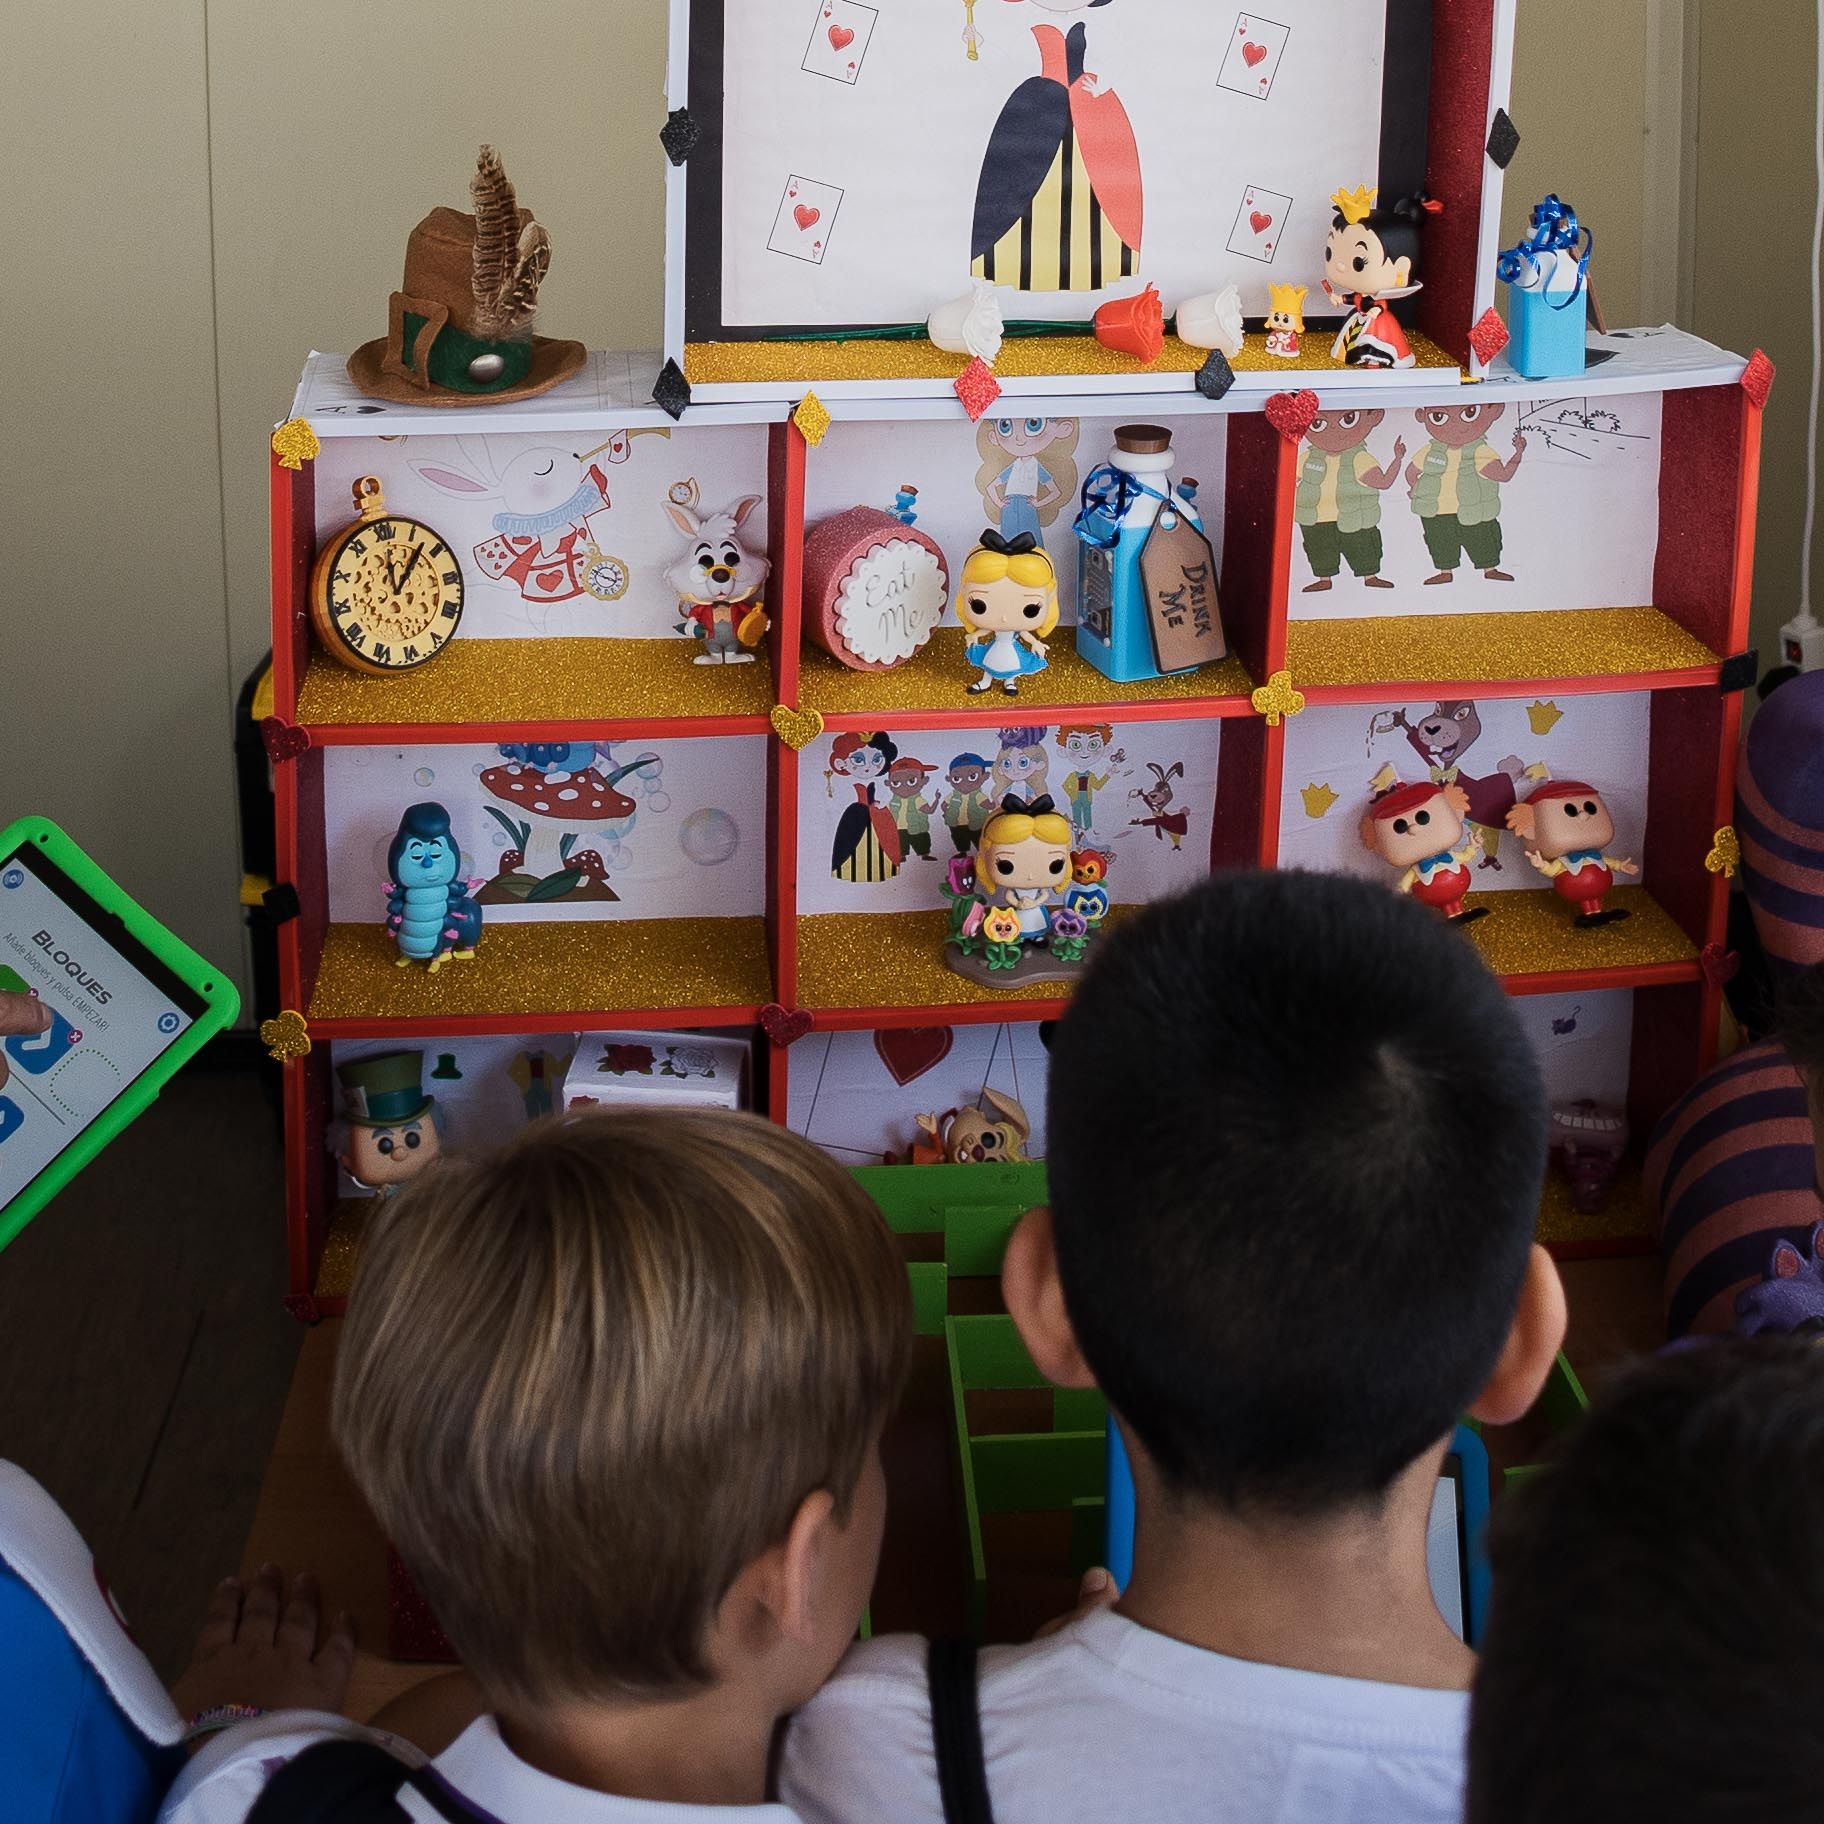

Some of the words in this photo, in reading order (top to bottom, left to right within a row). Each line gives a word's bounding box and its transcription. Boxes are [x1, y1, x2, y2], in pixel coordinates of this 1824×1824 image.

[865, 560, 916, 609] Eat
[878, 603, 925, 645] Me
[2, 932, 26, 955] Añade
[23, 950, 52, 980] bloques
[46, 976, 56, 986] y
[51, 980, 75, 1002] pulsa
[71, 996, 111, 1033] EMPEZAR!
[31, 928, 113, 1005] BLOQUES
